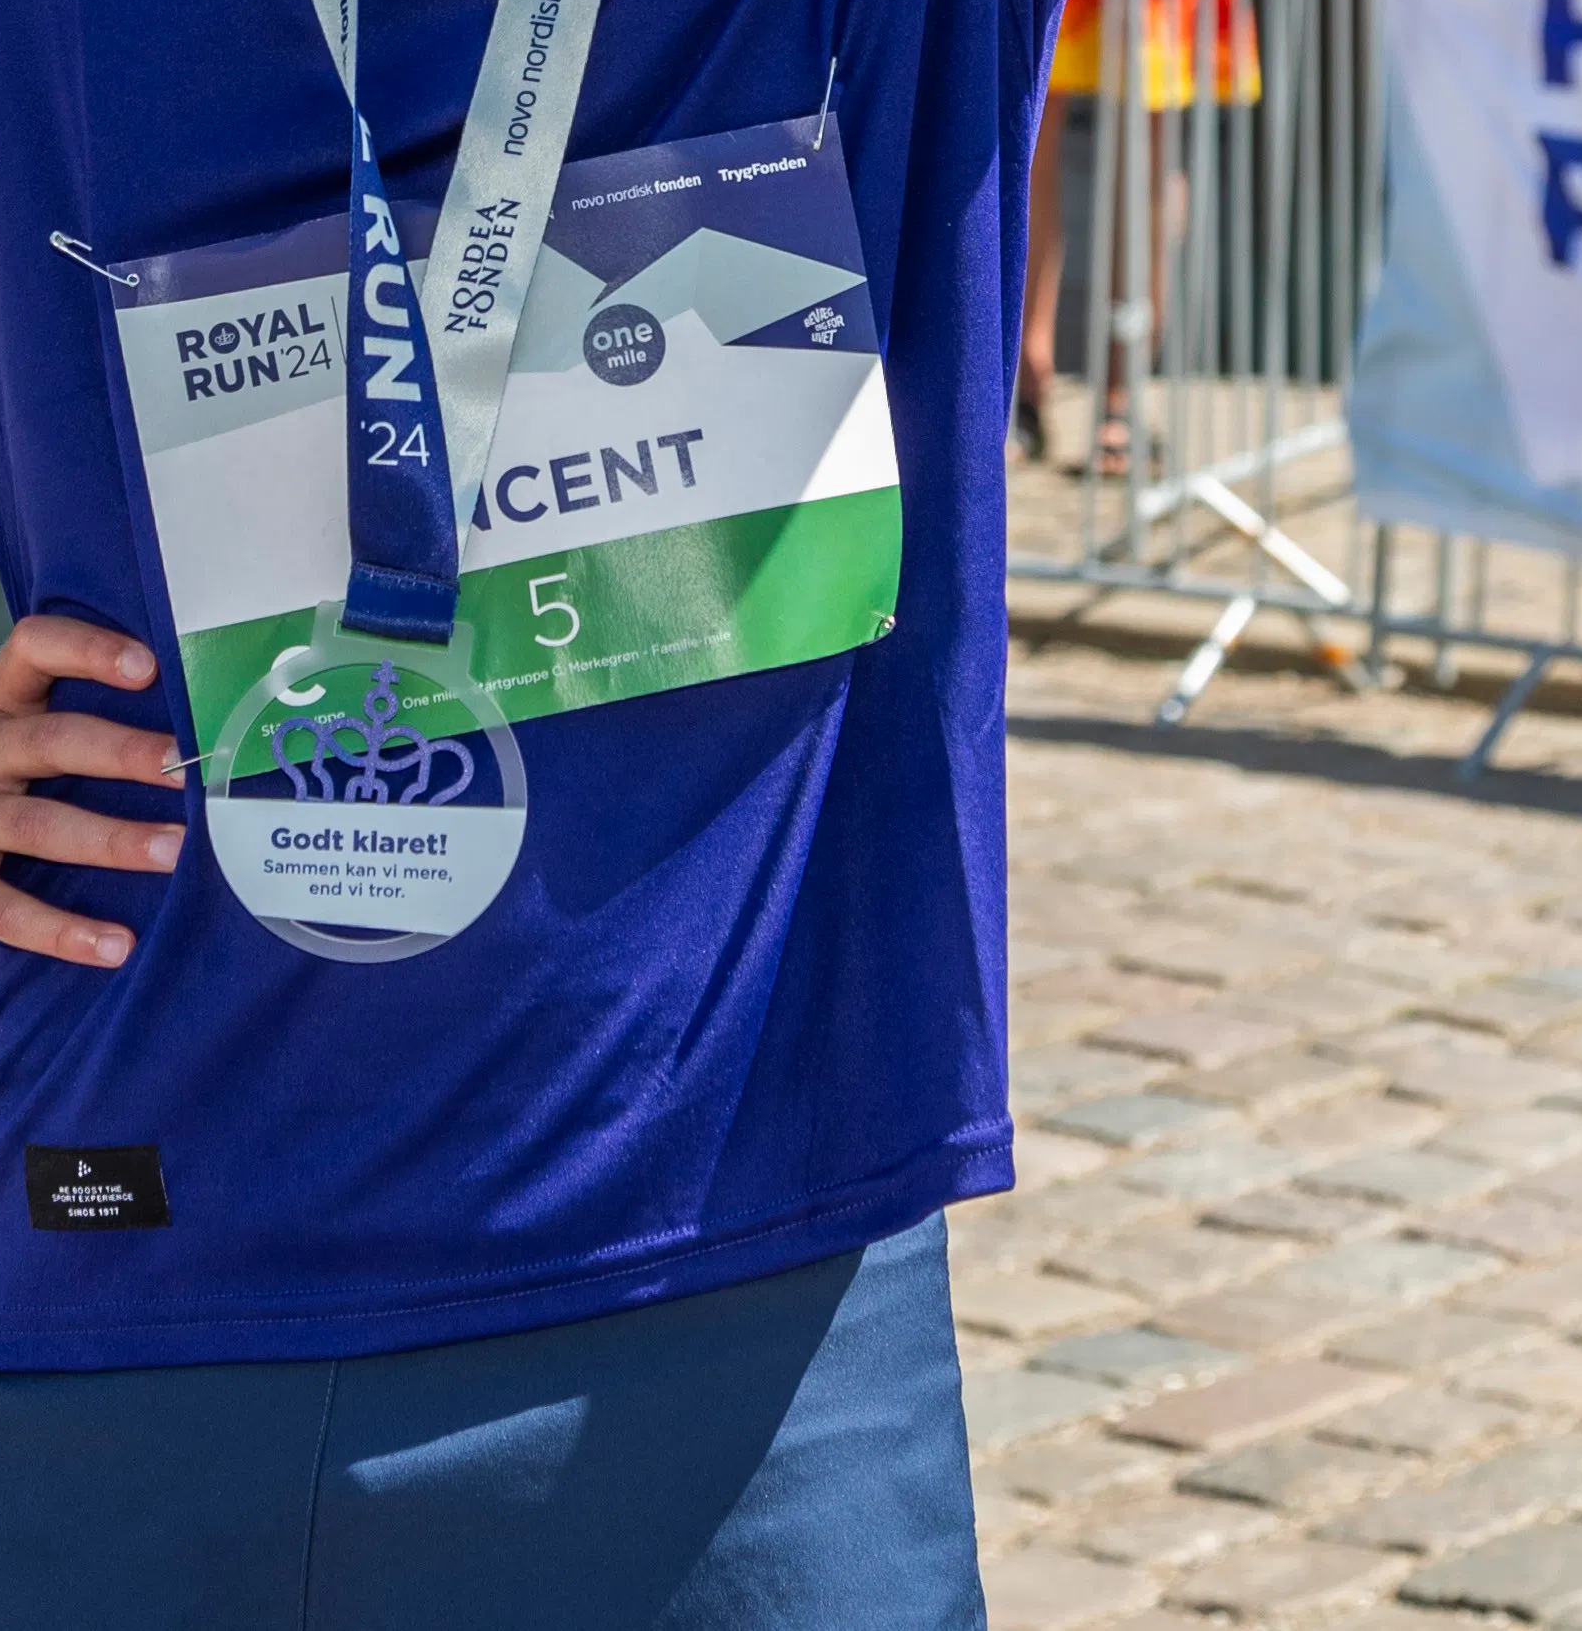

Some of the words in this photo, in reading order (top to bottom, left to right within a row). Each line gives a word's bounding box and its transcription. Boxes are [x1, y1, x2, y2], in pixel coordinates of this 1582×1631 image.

[502, 90, 538, 157] novo
[571, 194, 605, 211] novo
[606, 183, 654, 204] nordisk
[653, 174, 702, 194] fonden
[718, 156, 807, 183] TrygFonden
[445, 203, 498, 334] NORDEA
[468, 197, 521, 331] FONDEN
[362, 193, 422, 402] RUN
[176, 303, 325, 363] ROYAL
[592, 322, 654, 351] one
[607, 349, 647, 369] mile
[360, 421, 430, 467] '24
[528, 572, 580, 648] 5
[402, 696, 429, 710] One
[477, 669, 549, 693] tartgruppe
[567, 650, 639, 674] Mørkegrøn
[271, 827, 344, 852] Godt
[352, 829, 448, 856] klaret!
[263, 859, 340, 877] Sammen
[346, 861, 377, 878] kan
[382, 864, 398, 879] vi
[403, 867, 453, 883] mere,
[309, 881, 342, 897] end
[348, 882, 364, 897] vi
[368, 884, 406, 899] tror.
[68, 1208, 95, 1217] SINCE
[72, 1185, 103, 1195] BOOST
[105, 1184, 122, 1193] THE
[78, 1193, 134, 1203] EXPERIENCE
